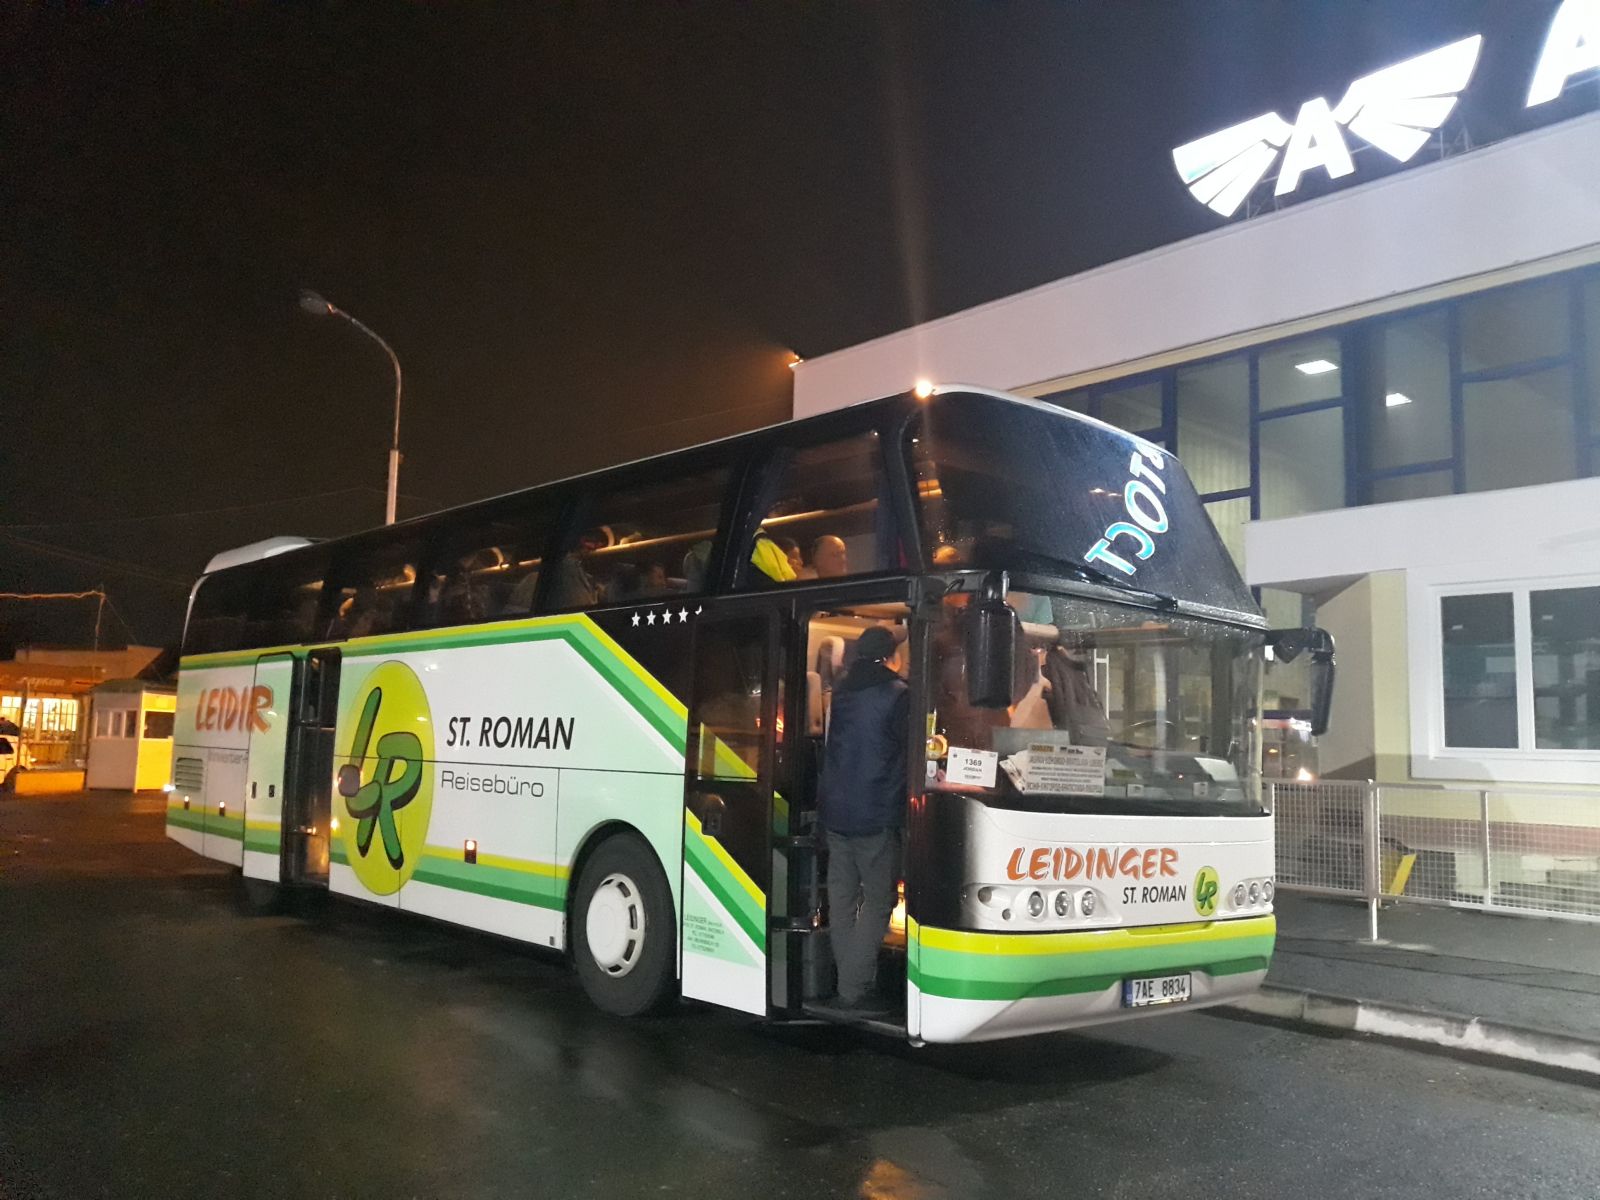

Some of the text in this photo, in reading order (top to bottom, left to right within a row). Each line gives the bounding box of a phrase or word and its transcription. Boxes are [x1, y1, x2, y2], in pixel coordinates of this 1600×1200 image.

[446, 716, 575, 751] ST. ROMAN
[965, 758, 983, 767] 1369
[441, 770, 545, 798] Reisebüro
[1006, 847, 1180, 881] LEIDINGER
[1122, 884, 1187, 905] ST. ROMAN
[1134, 980, 1155, 999] 7AE
[1162, 977, 1186, 997] 8834
